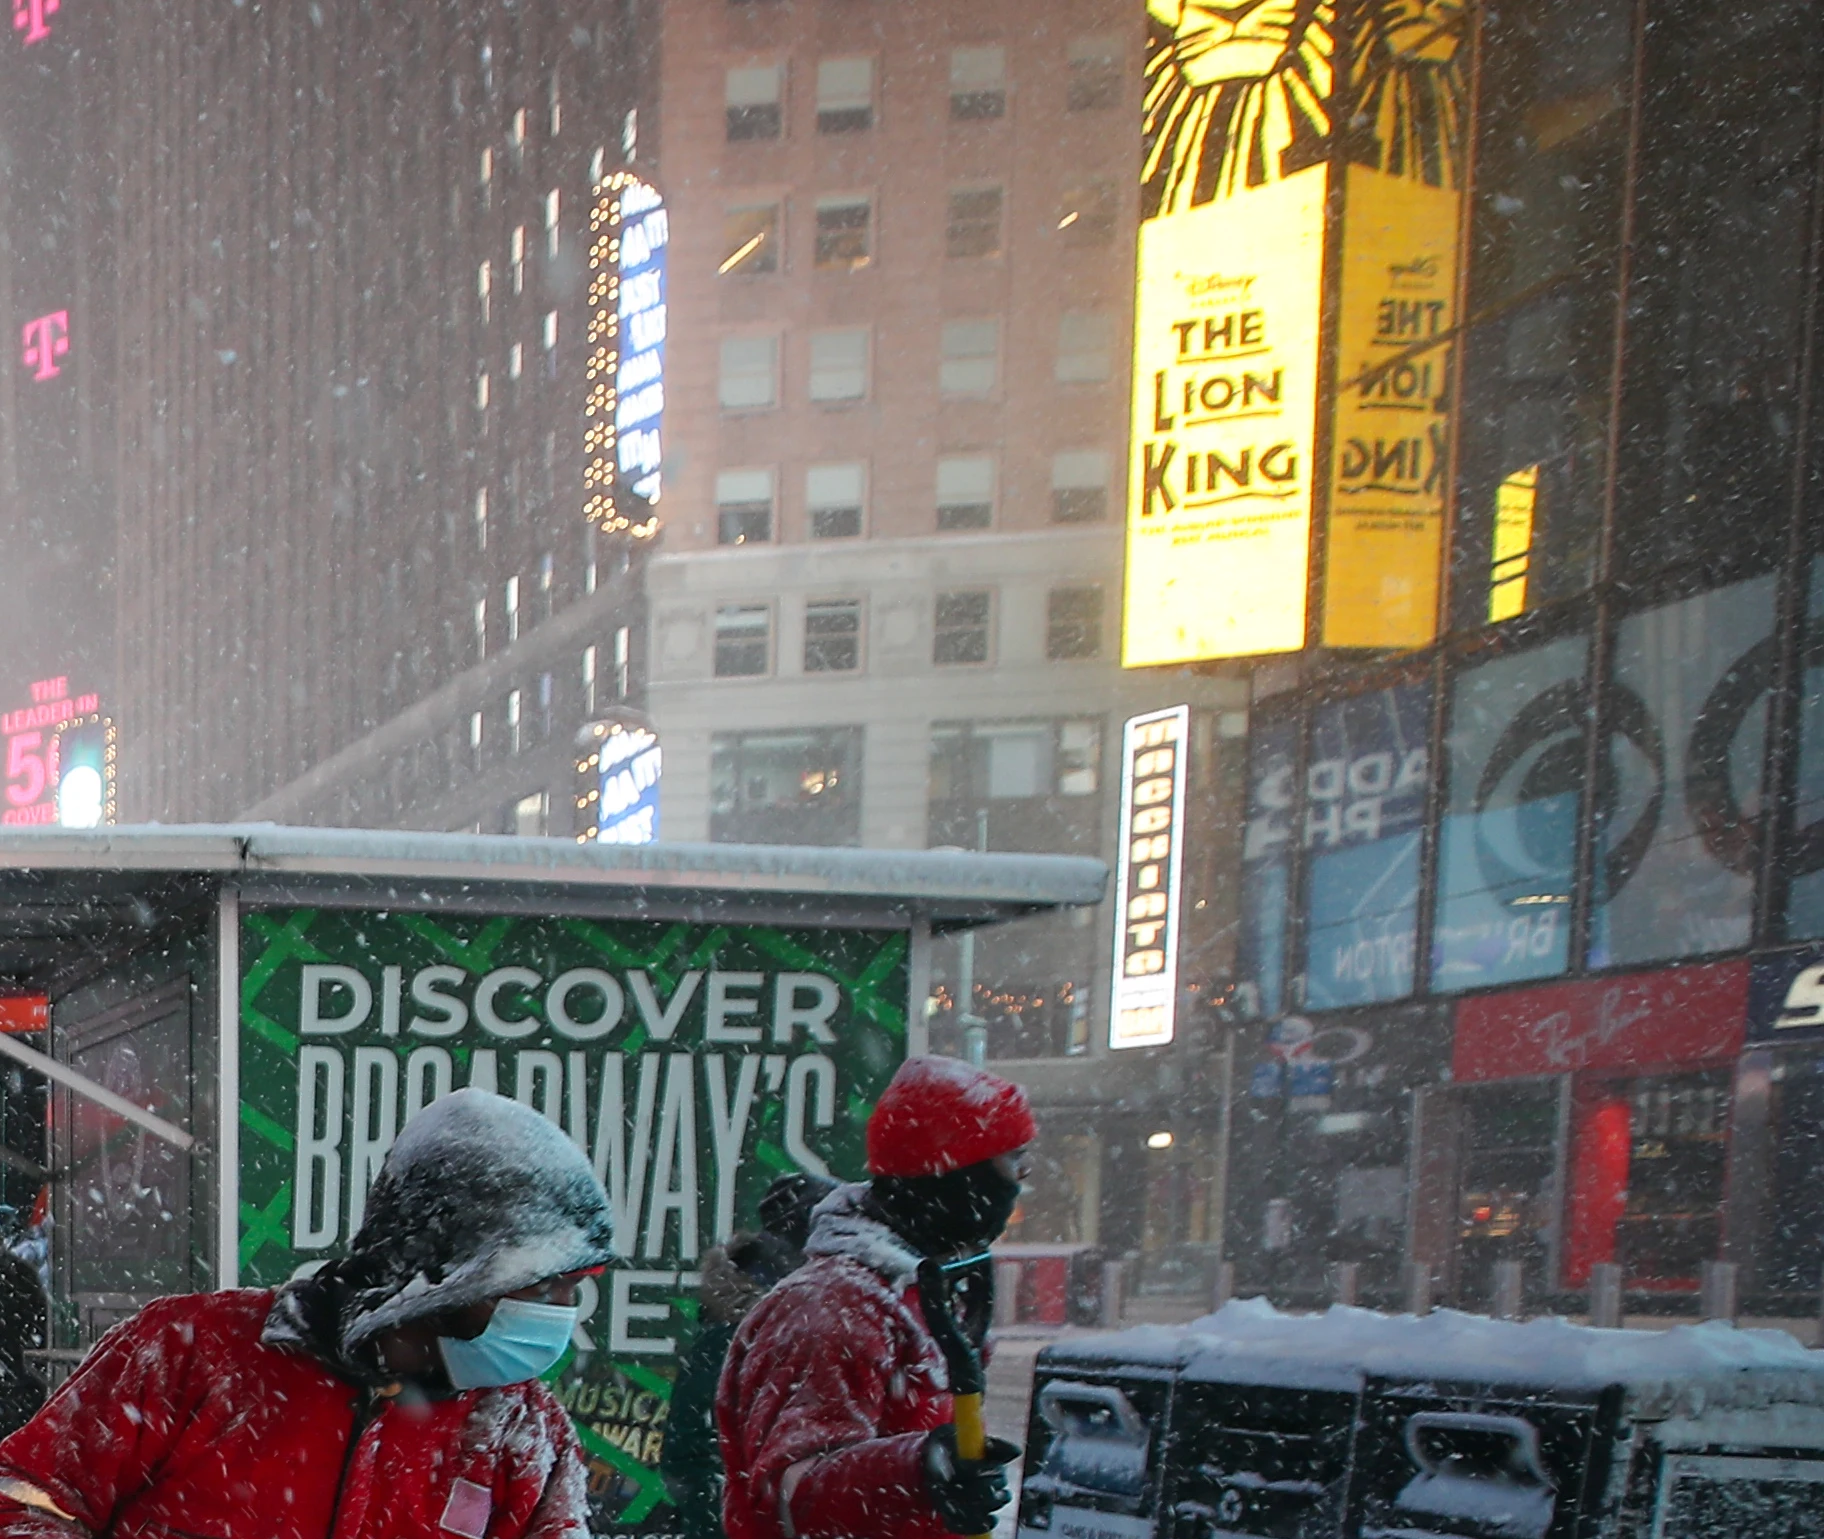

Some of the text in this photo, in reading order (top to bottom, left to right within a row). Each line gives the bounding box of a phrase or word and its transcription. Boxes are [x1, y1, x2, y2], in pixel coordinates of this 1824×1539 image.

[1172, 312, 1263, 354] THE
[1153, 369, 1282, 433] LION
[1141, 443, 1301, 517] KING
[1, 693, 99, 735] LEADER IN
[31, 676, 68, 702] THE
[298, 961, 842, 1045] DISCOVER
[294, 1043, 838, 1260] BRWAY'S
[553, 1383, 671, 1425] MUSICA
